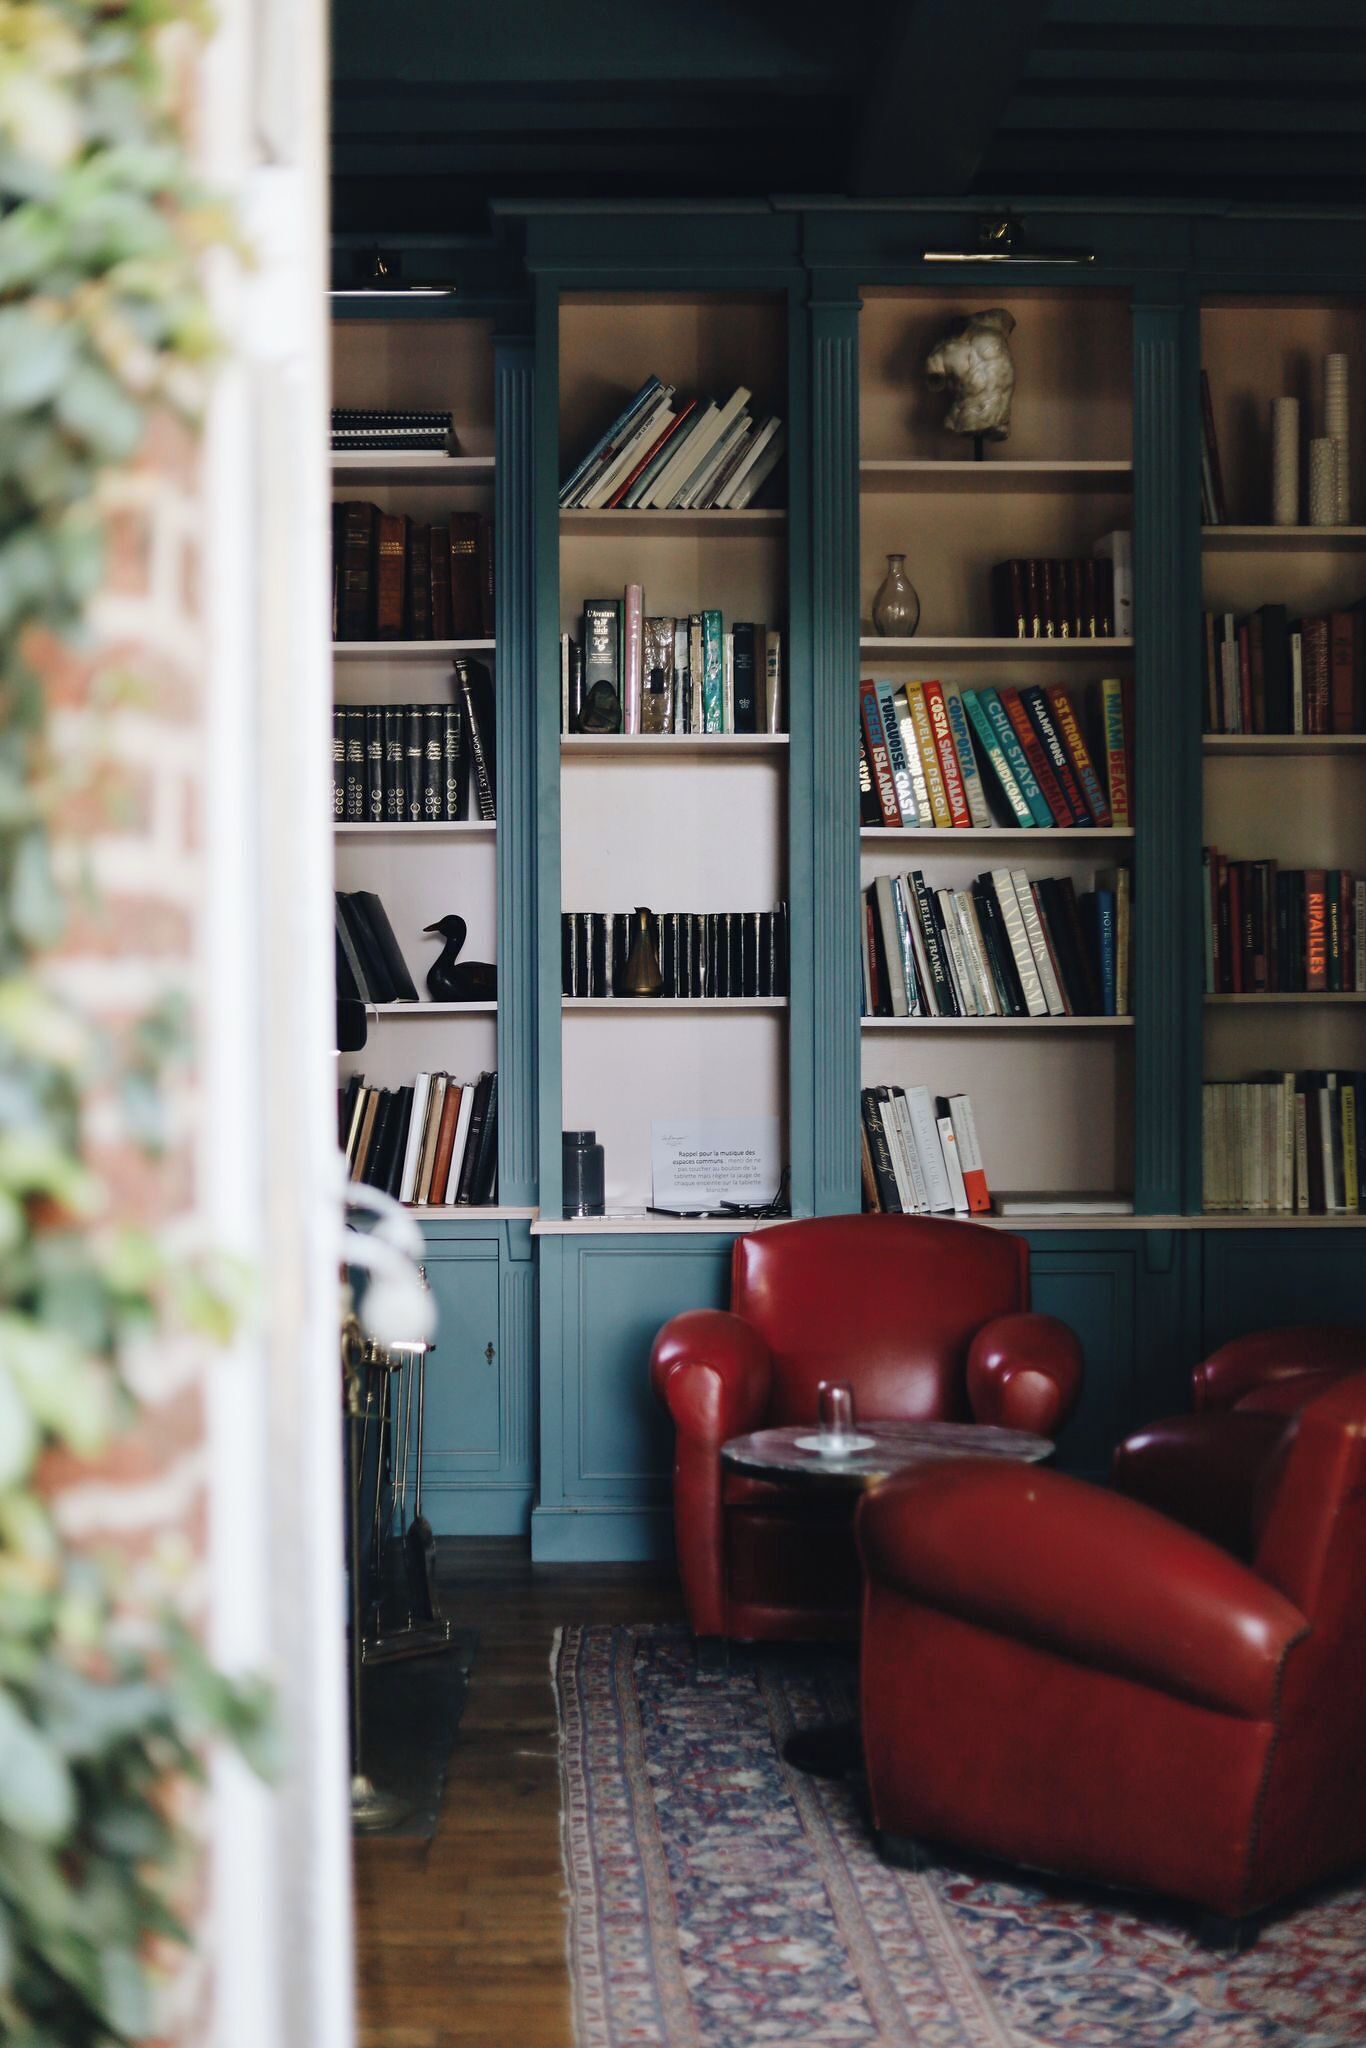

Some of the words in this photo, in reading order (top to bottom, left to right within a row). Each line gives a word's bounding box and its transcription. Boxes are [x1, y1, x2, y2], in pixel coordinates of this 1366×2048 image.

[912, 695, 931, 749] TRAVEL
[931, 696, 949, 739] COSTA
[949, 696, 976, 778] COMPORTA
[1032, 699, 1065, 766] HAMPTONS
[1106, 694, 1123, 750] MIAMI
[472, 736, 482, 763] WORLD
[477, 765, 487, 787] ATLAS
[880, 696, 905, 771] TURQUOISE
[895, 771, 915, 816] COAST
[924, 747, 935, 763] BY
[987, 702, 1014, 742] CHIC
[1008, 746, 1039, 798] STAYS
[873, 747, 897, 816] ISLANDS
[927, 767, 947, 816] DESIGN
[939, 740, 964, 824] SMERALDA
[990, 748, 1012, 783] SAUDI
[1006, 782, 1028, 817] COAST
[1110, 751, 1127, 813] BEACH
[915, 879, 925, 895] LA
[919, 899, 934, 934] BELLE
[996, 876, 1044, 1007] MAXIMALISM
[1014, 884, 1045, 962] FLOWERS
[1309, 893, 1326, 974] RIPAILLES
[927, 935, 944, 983] FRANCE
[867, 1097, 883, 1132] Garcia
[876, 1138, 896, 1181] Jacques
